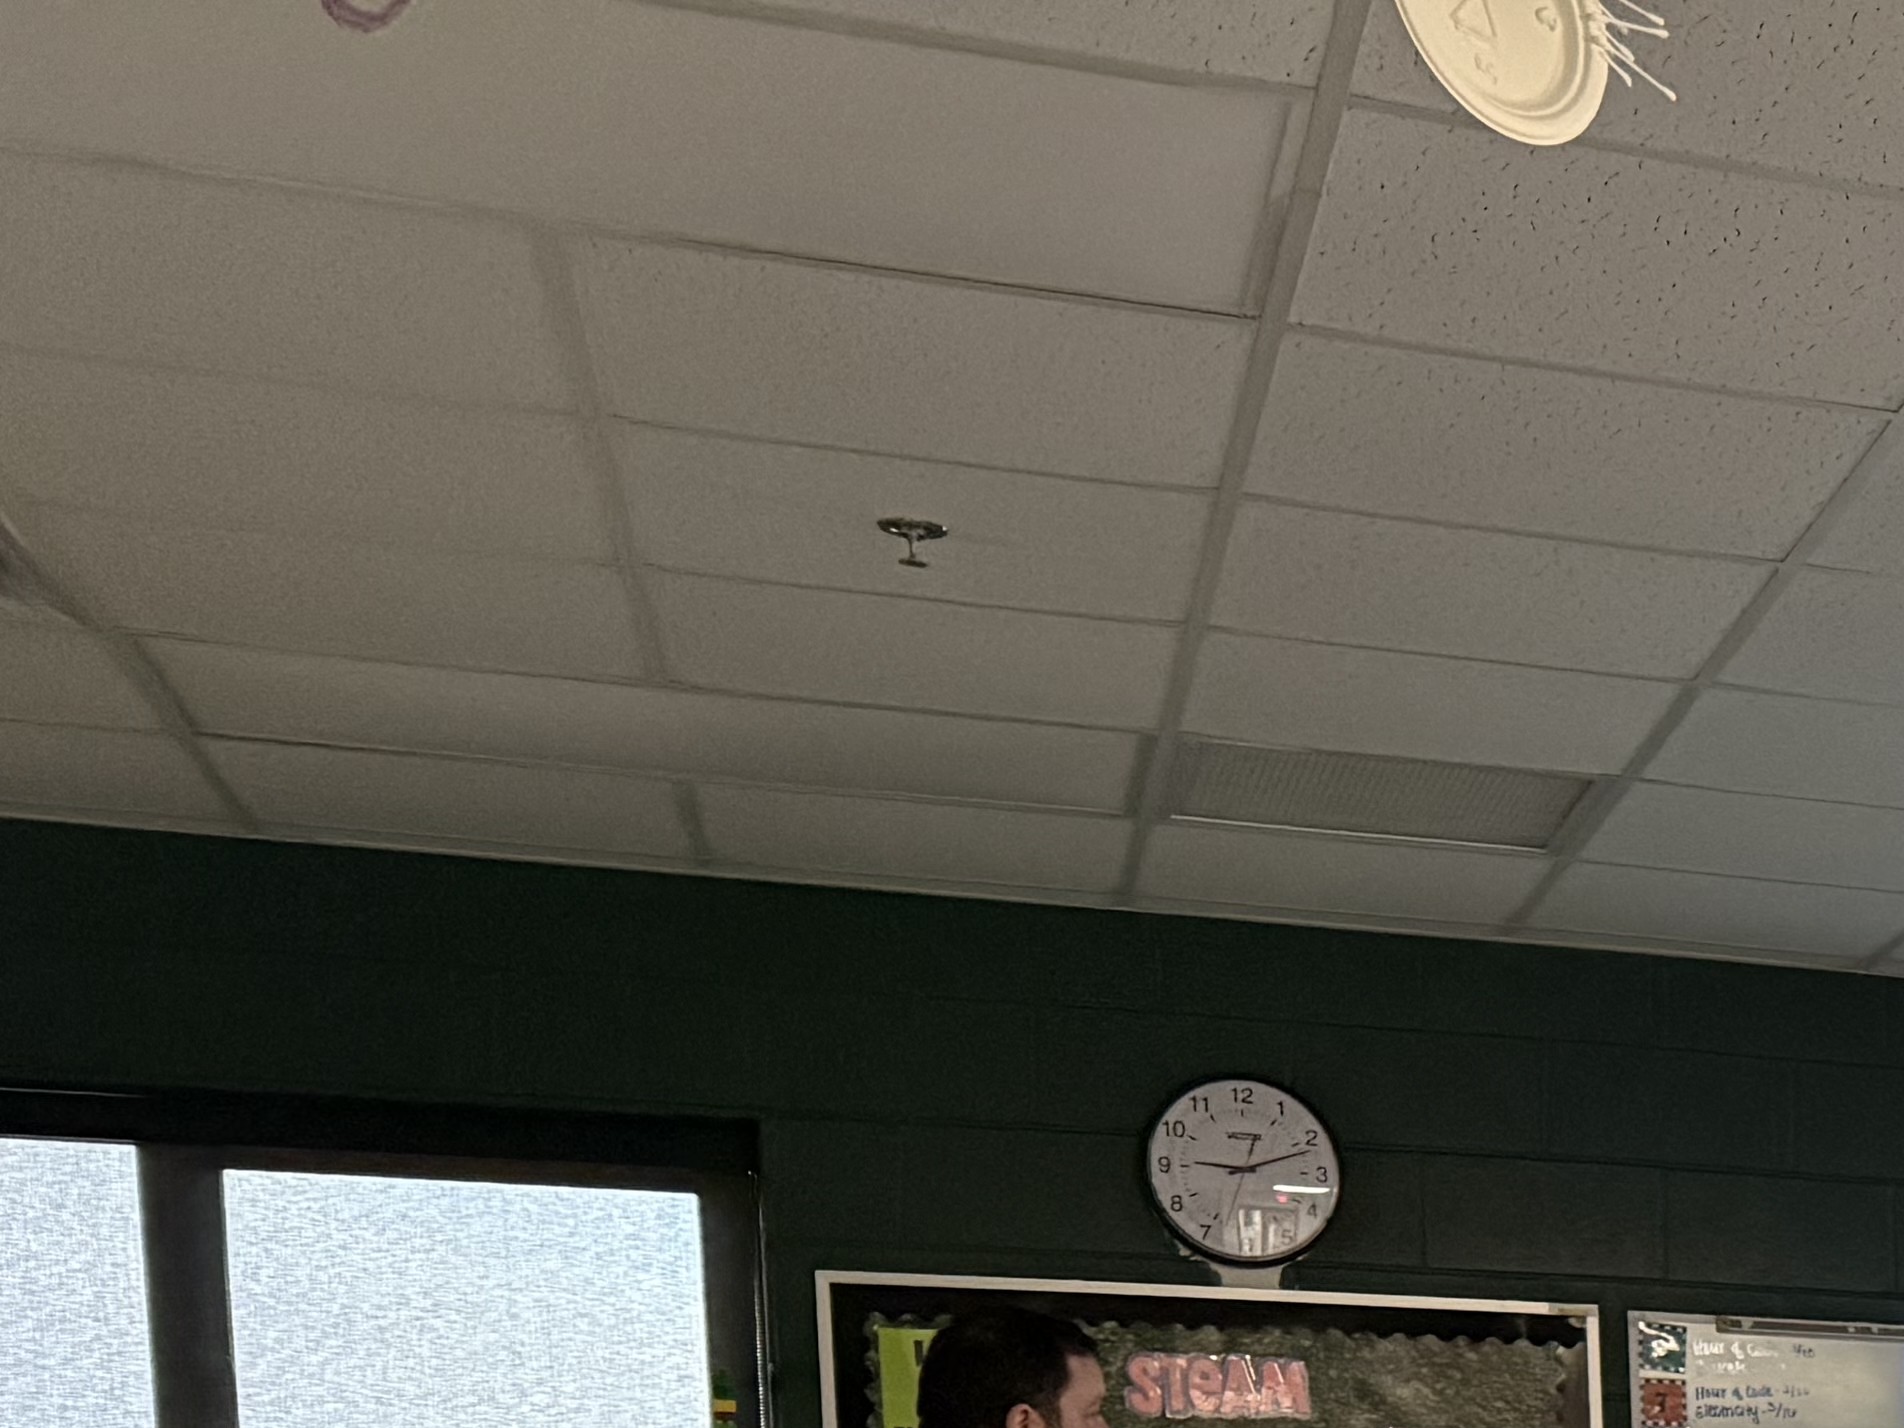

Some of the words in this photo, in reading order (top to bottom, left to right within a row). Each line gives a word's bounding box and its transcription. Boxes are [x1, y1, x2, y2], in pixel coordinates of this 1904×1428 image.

[1189, 1096, 1210, 1113] 11
[1231, 1087, 1254, 1105] 12
[1276, 1101, 1285, 1117] 1
[1162, 1120, 1186, 1138] 10
[1304, 1130, 1319, 1147] 2
[1157, 1156, 1172, 1174] 9
[1315, 1166, 1328, 1183] 3
[1170, 1195, 1183, 1212] 8
[1306, 1203, 1318, 1219] 4
[1199, 1224, 1212, 1241] 7
